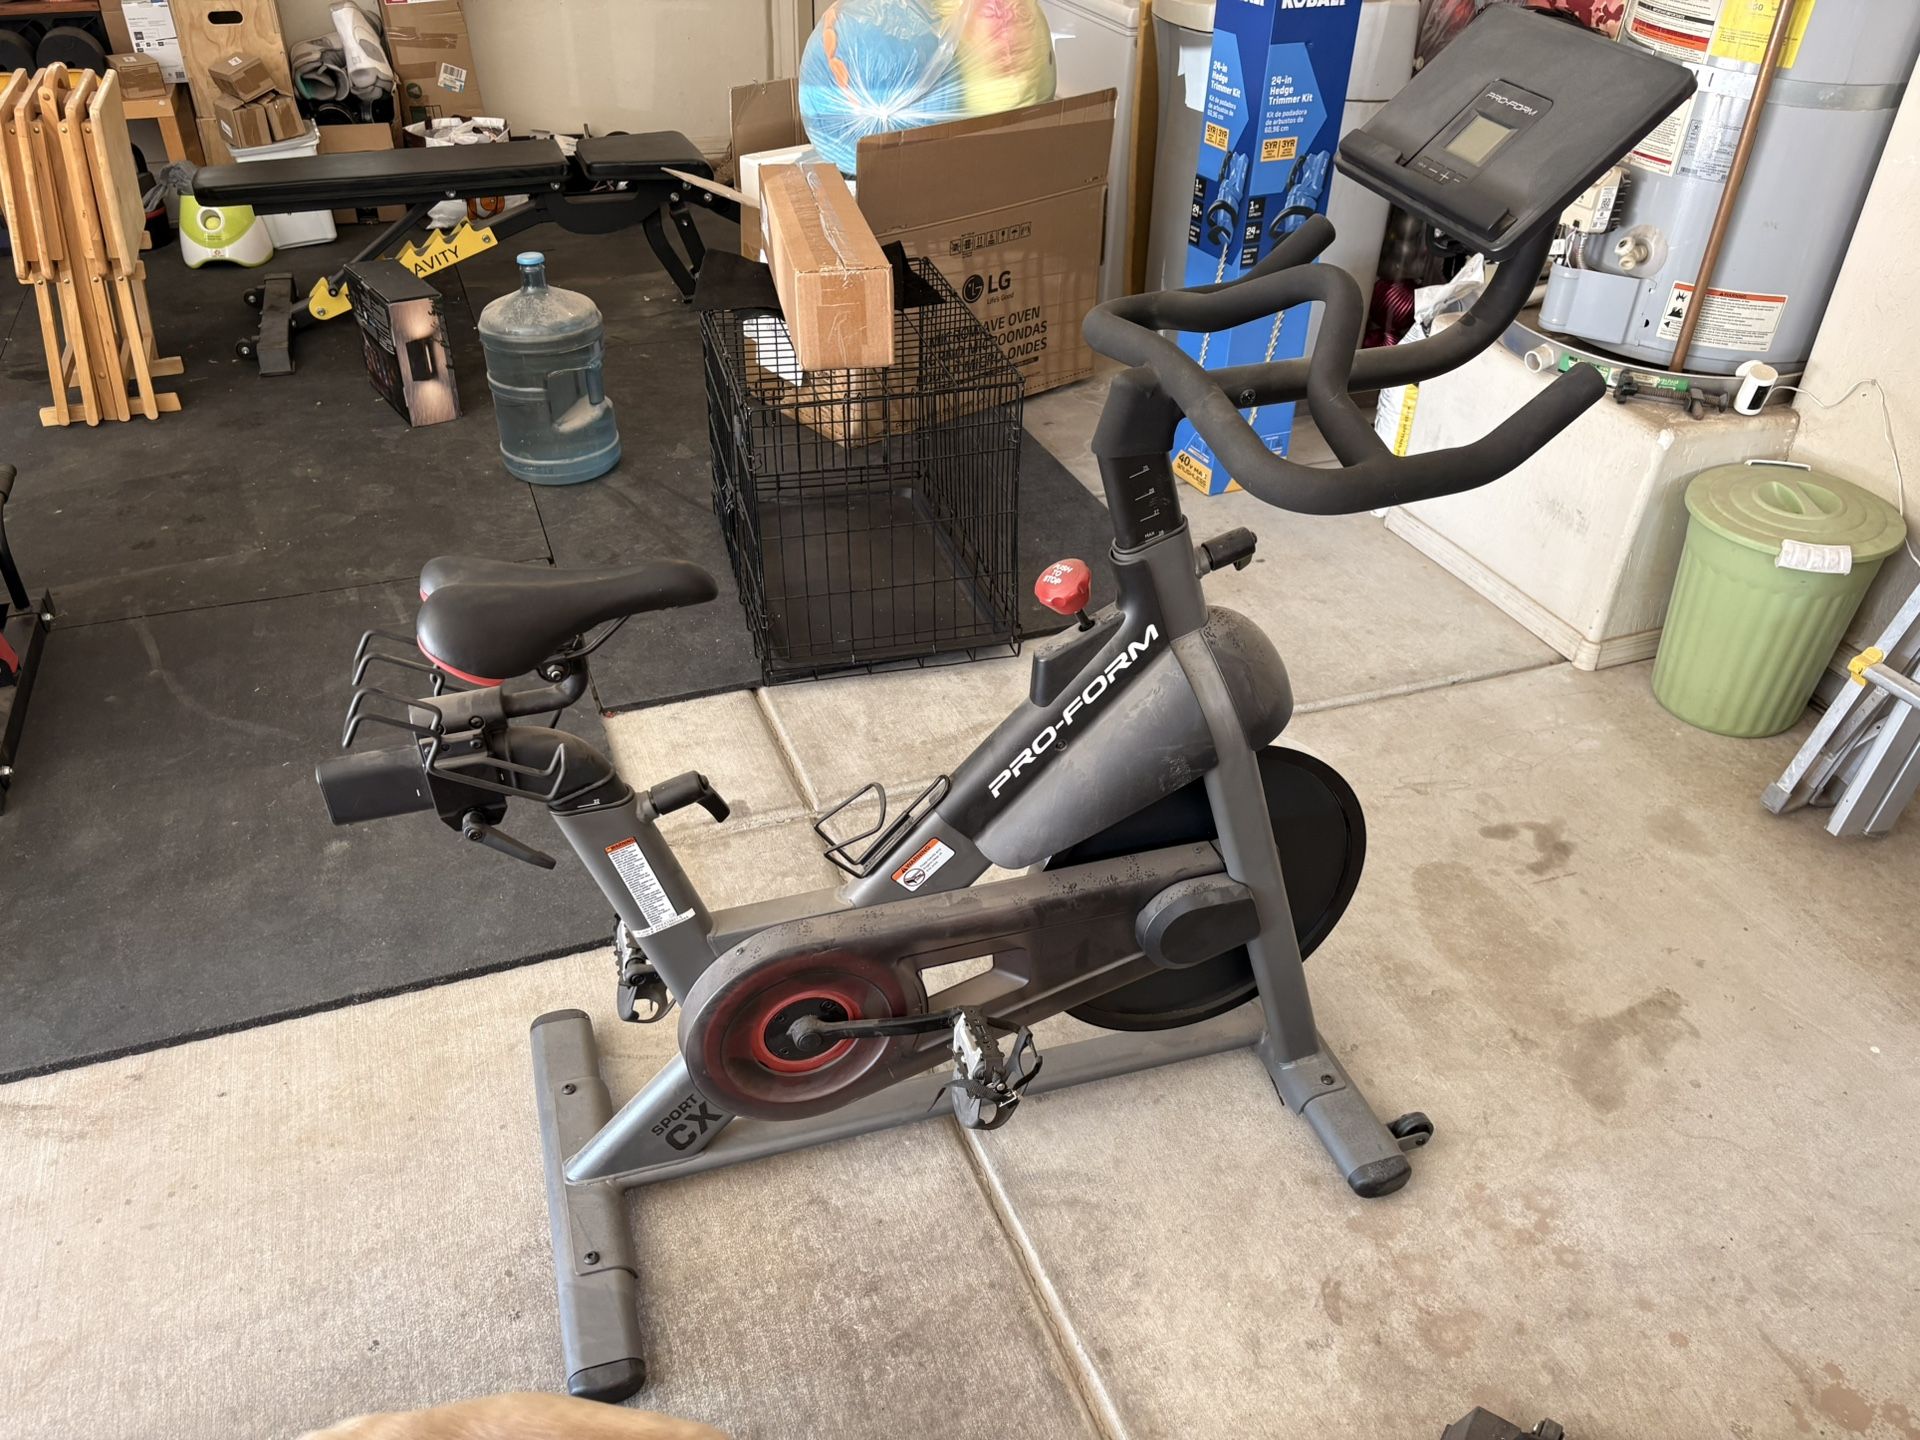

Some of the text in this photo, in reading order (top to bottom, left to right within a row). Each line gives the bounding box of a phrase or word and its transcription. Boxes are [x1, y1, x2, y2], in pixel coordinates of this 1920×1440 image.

[1213, 60, 1228, 73] 24-in
[1212, 70, 1229, 84] Hedge
[1271, 75, 1292, 85] 24-in
[1211, 80, 1241, 98] Trimmer Kit
[1269, 85, 1294, 97] Hedge
[1268, 92, 1313, 105] Trimmer Kit
[1485, 92, 1538, 116] PRO-FORM
[1281, 109, 1307, 118] podadora
[1265, 118, 1272, 126] de
[1206, 125, 1217, 136] 5YR
[1217, 129, 1228, 140] 3YR
[1264, 139, 1296, 150] 5YR 3YR
[1246, 226, 1256, 236] 24
[988, 270, 1011, 294] LG
[1008, 306, 1041, 326] OVEN
[1042, 574, 1062, 585] STOP
[1052, 569, 1062, 577] TO
[988, 624, 1159, 799] PRO-FORM
[907, 845, 931, 868] WARNING
[651, 1094, 697, 1136] SPORT
[665, 1101, 723, 1151] CX
